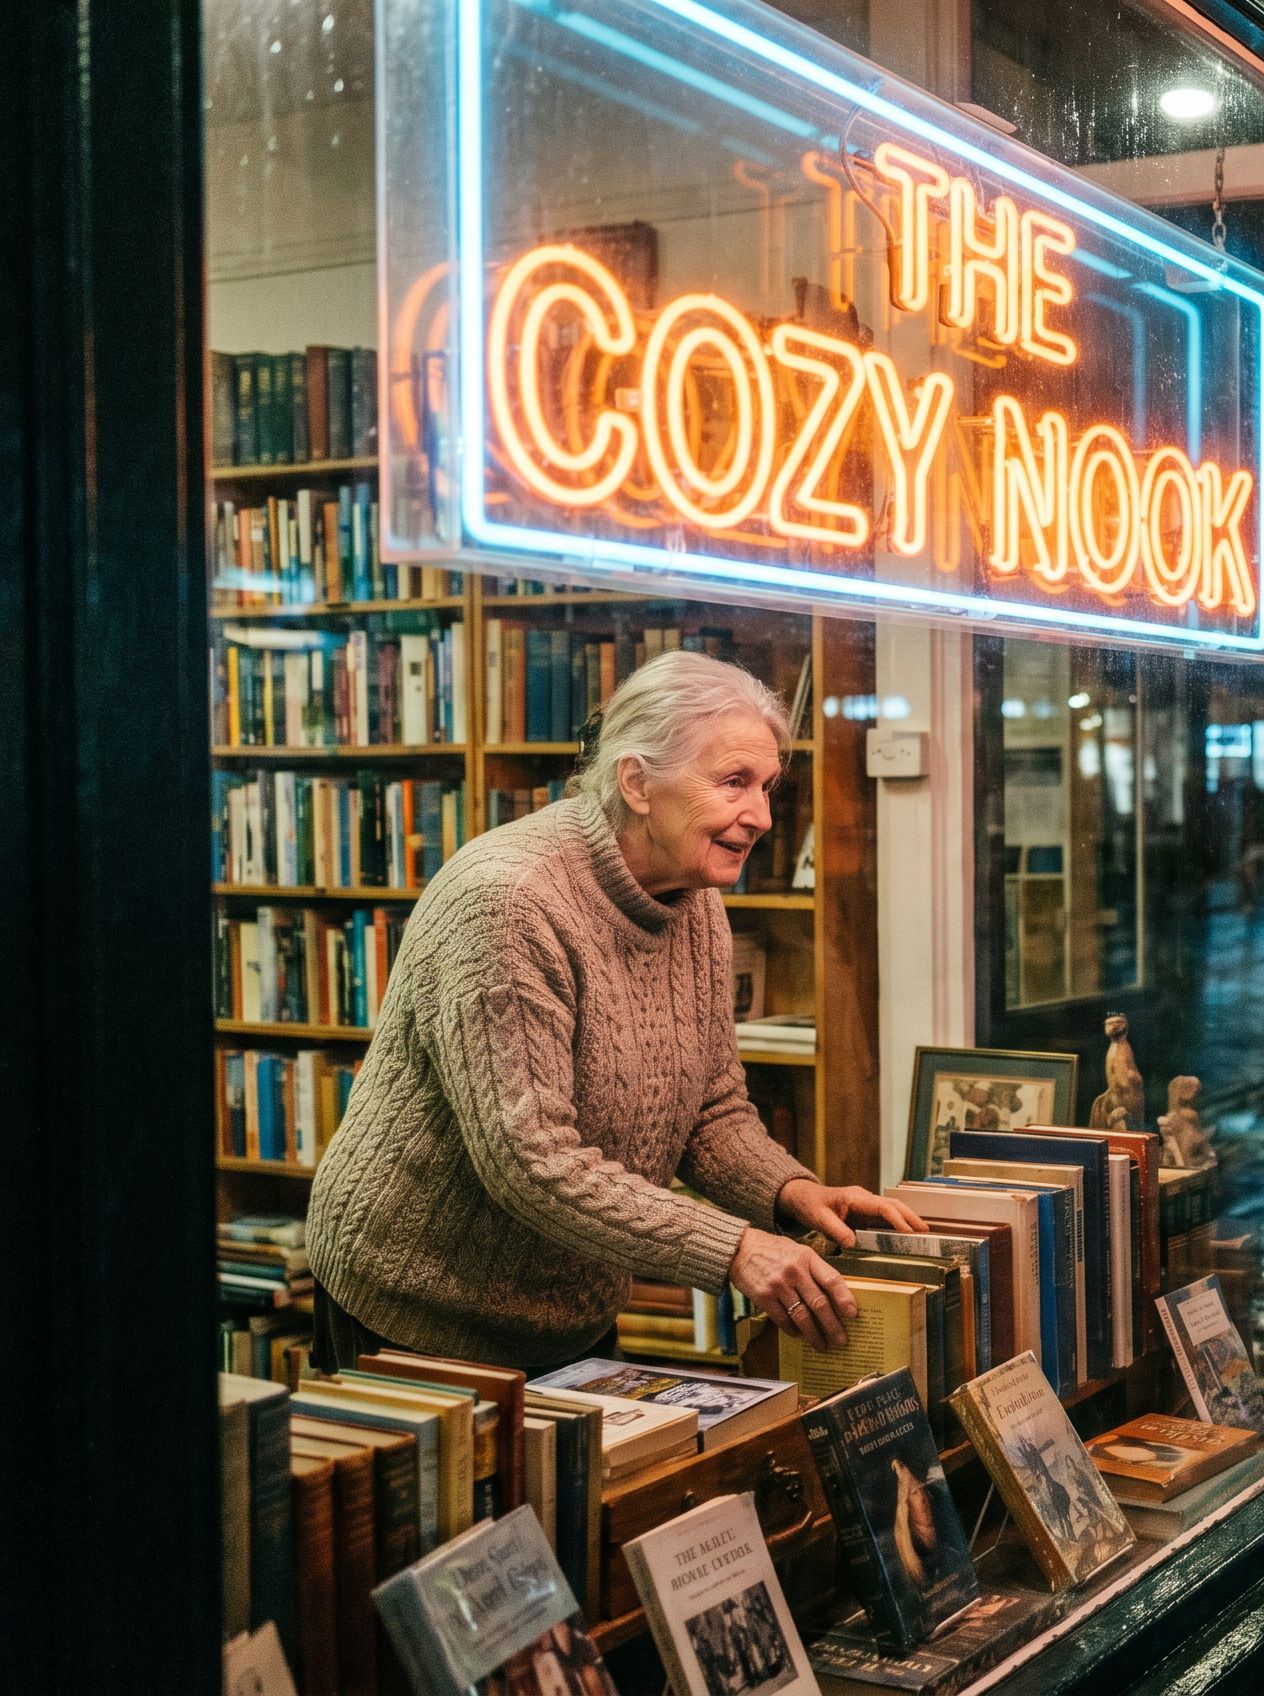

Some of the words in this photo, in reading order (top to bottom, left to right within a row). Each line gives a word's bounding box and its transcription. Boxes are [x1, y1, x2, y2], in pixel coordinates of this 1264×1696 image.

[874, 141, 1077, 366] THE
[490, 244, 955, 556] COZY
[989, 394, 1256, 617] NOOK
[673, 1546, 698, 1567] THE
